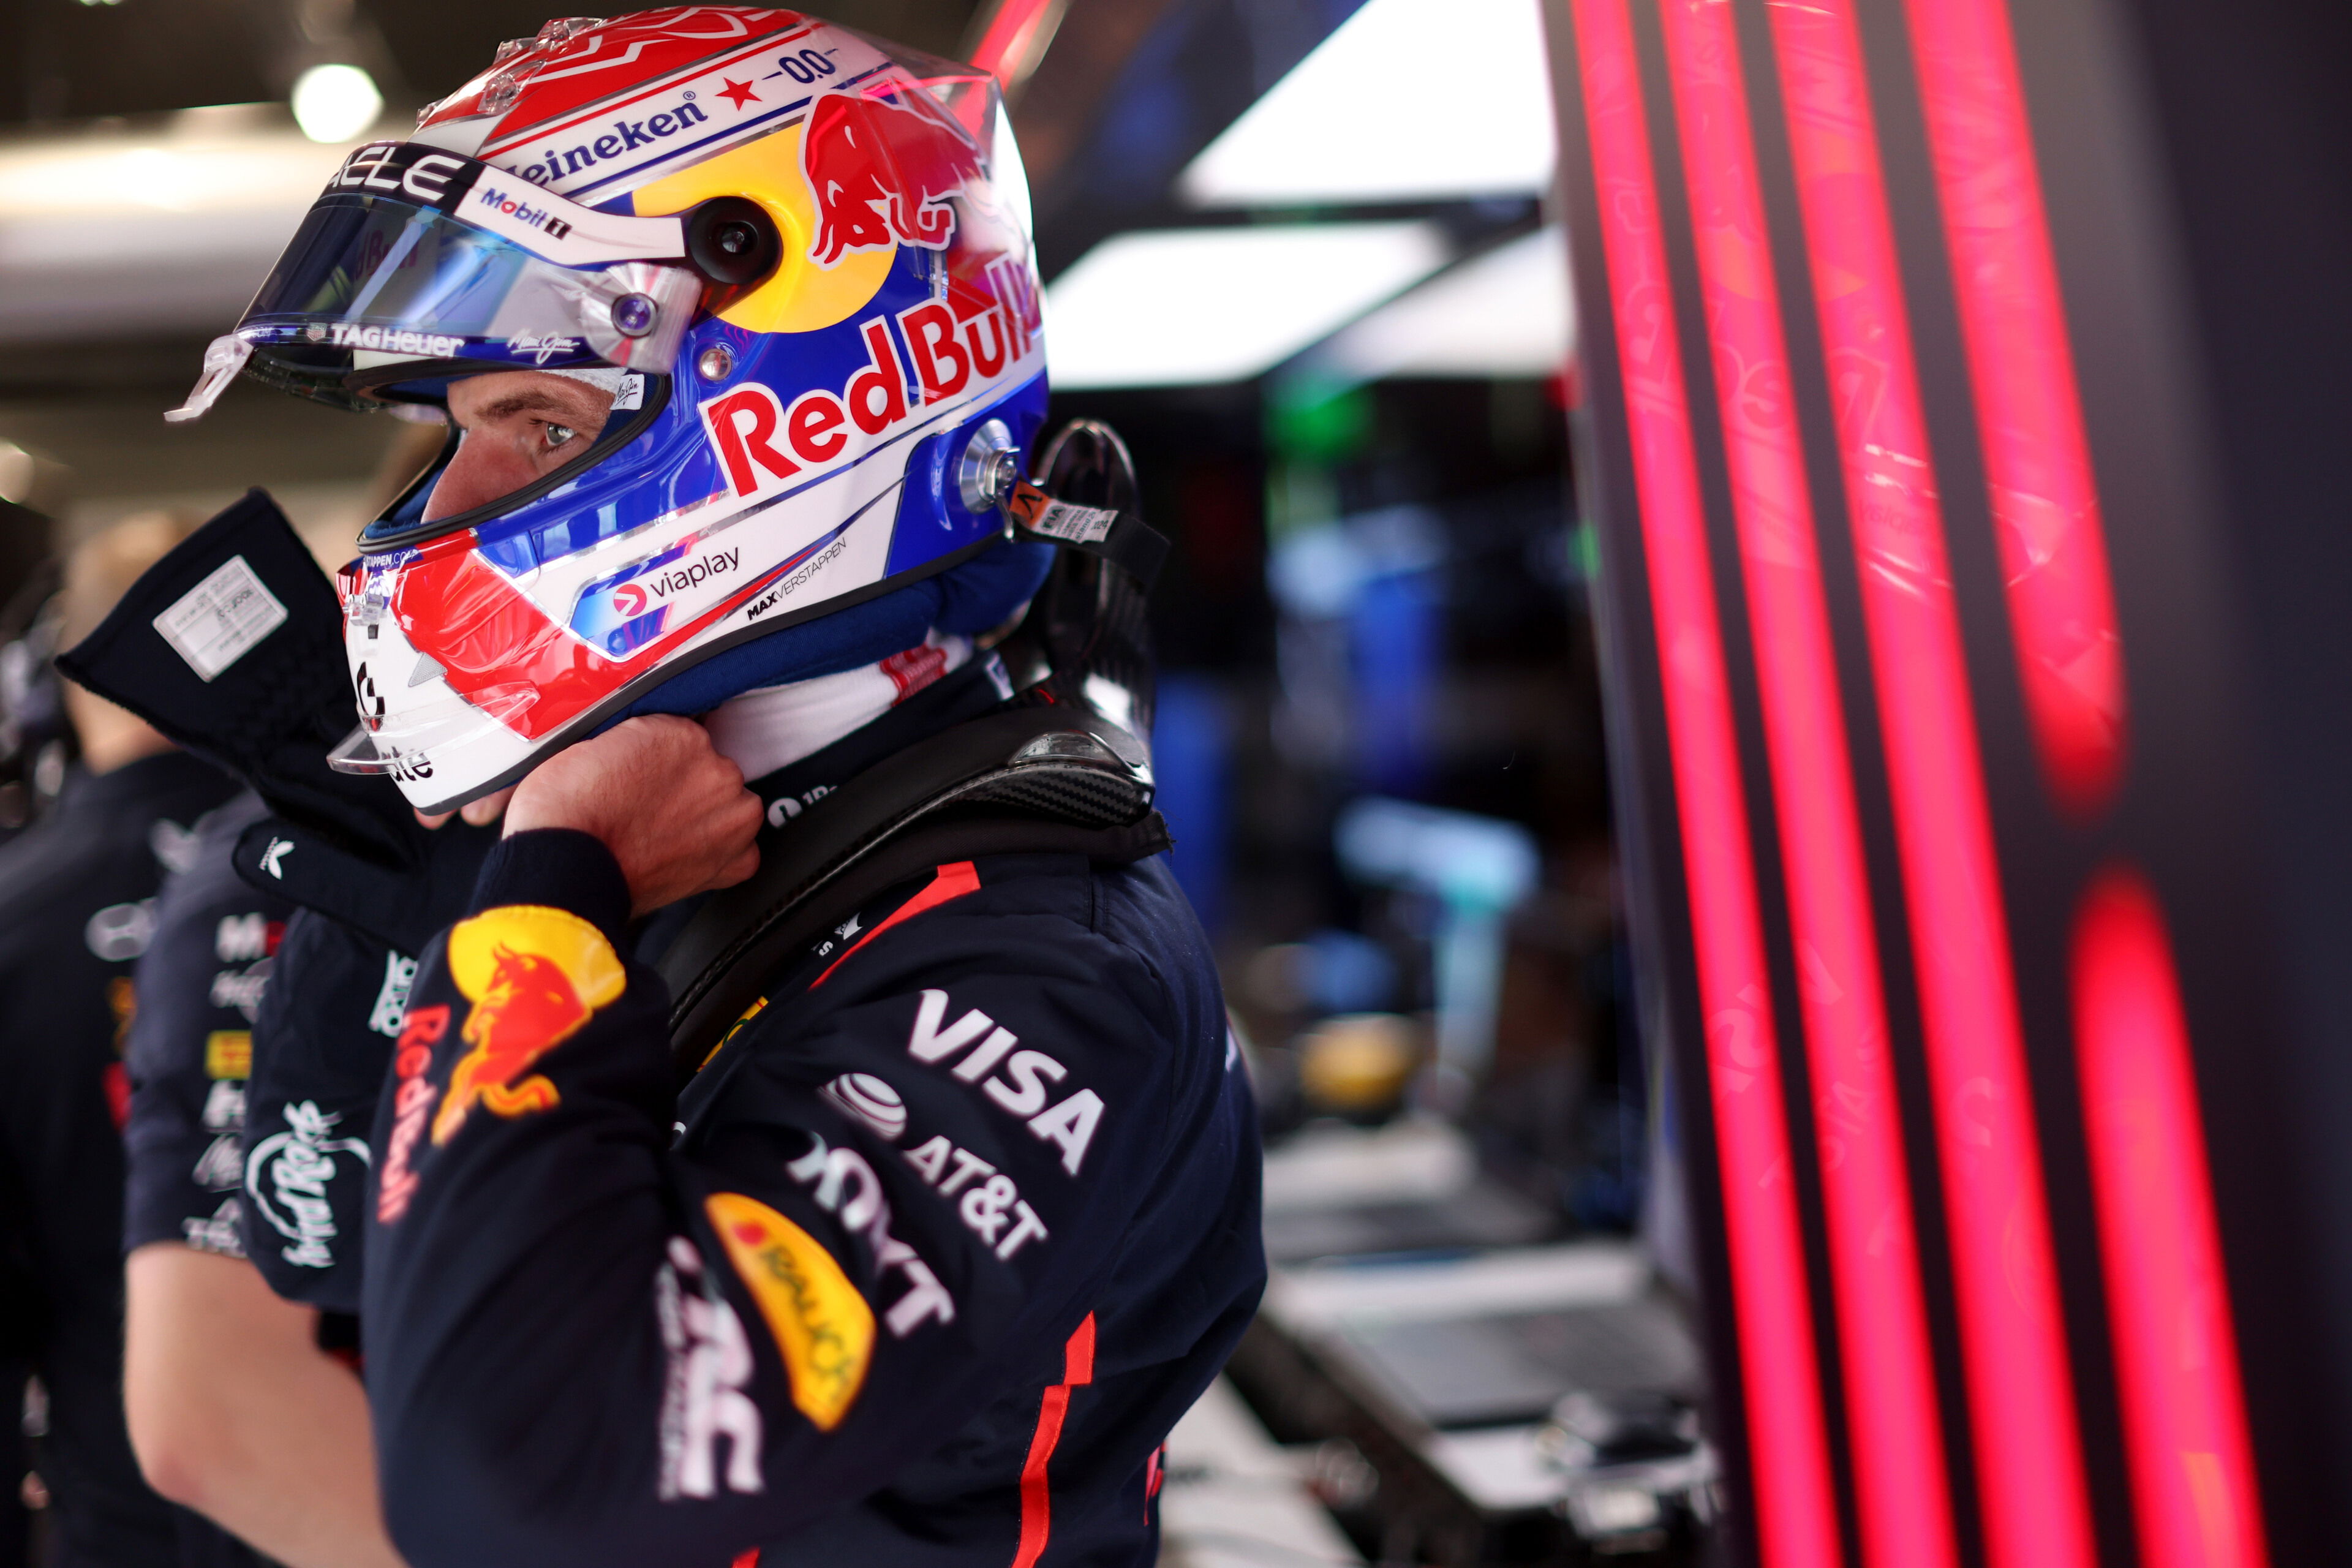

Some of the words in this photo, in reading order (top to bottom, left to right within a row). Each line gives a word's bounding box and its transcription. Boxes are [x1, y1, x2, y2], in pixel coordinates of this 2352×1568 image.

[506, 102, 709, 187] eineken
[481, 187, 548, 228] Mobil
[707, 323, 907, 497] Red
[902, 259, 1031, 407] Bull
[650, 546, 739, 598] viaplay
[396, 1004, 451, 1118] Red
[908, 988, 1104, 1176] VISA
[902, 1134, 1049, 1261] AT&T
